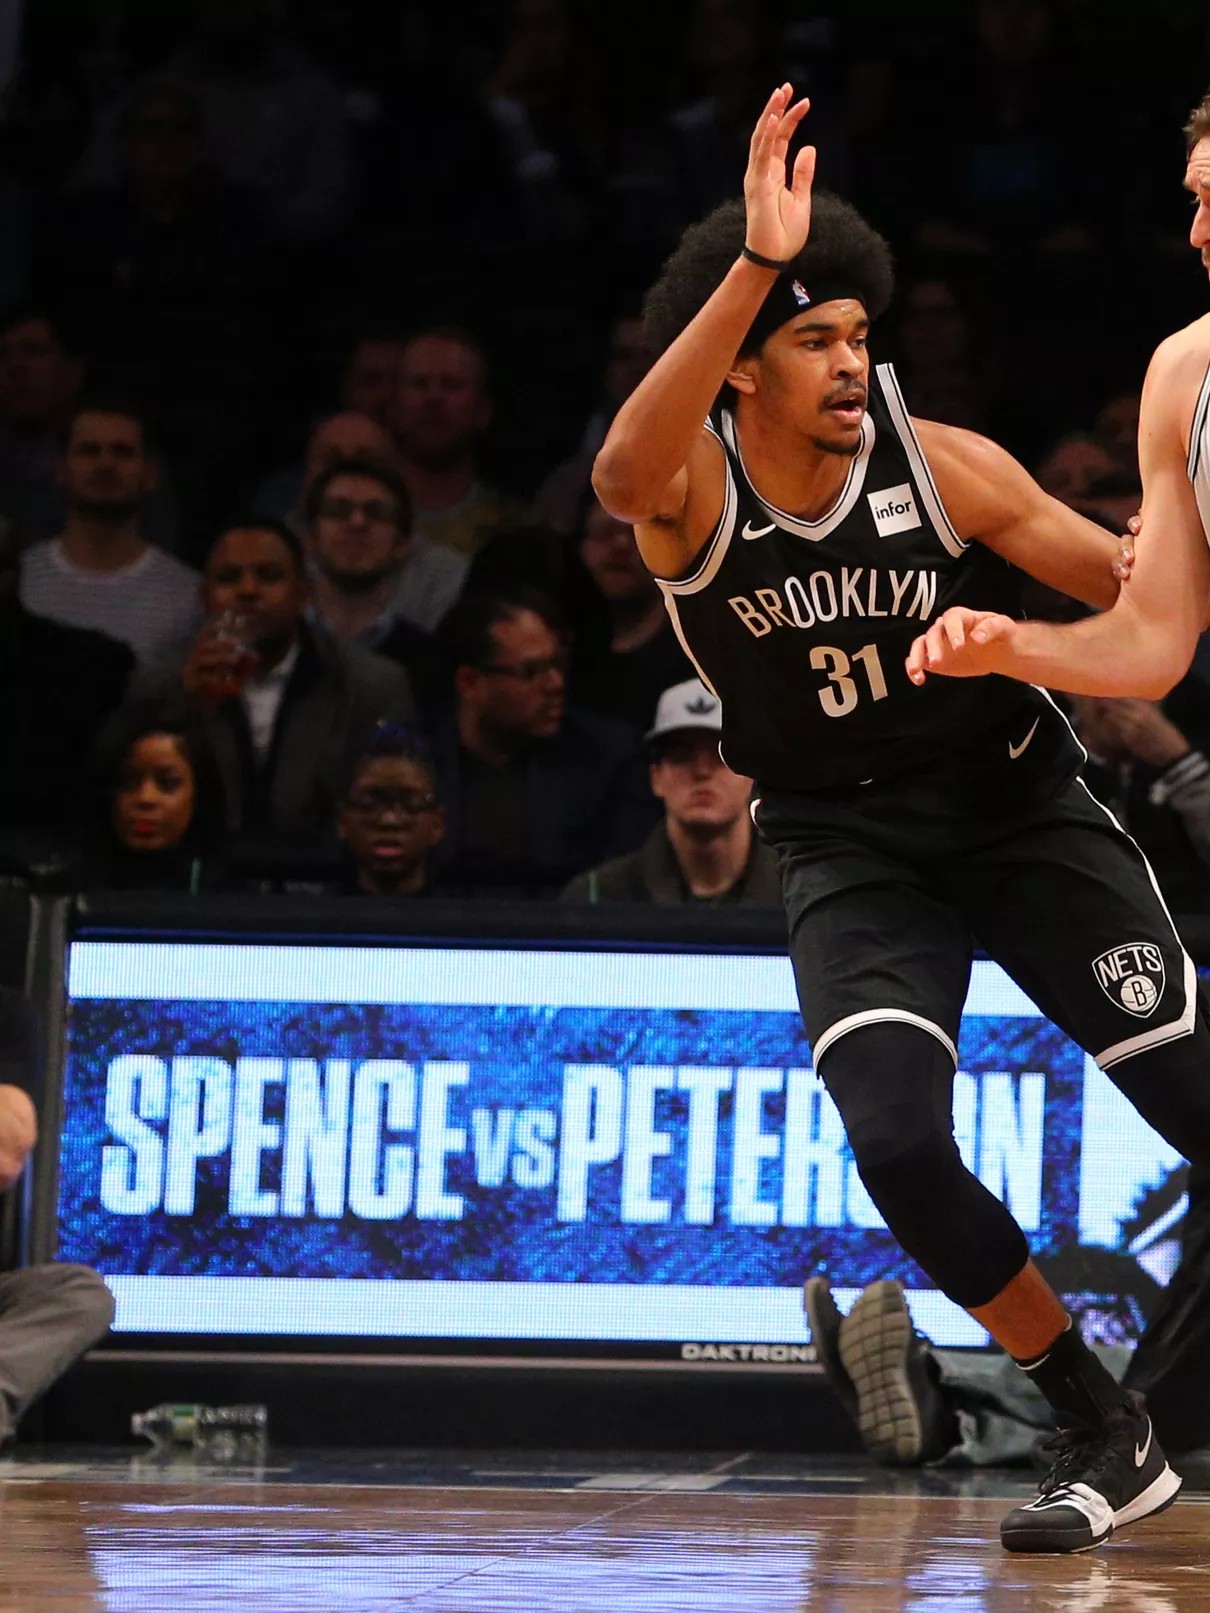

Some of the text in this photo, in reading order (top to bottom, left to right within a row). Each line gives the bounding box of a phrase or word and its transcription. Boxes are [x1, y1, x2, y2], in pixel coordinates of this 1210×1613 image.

[874, 499, 912, 520] infor
[727, 566, 937, 638] BROOKLYN
[809, 643, 888, 718] 31
[1098, 945, 1161, 988] NETS
[1131, 980, 1147, 1007] B
[100, 1053, 470, 1220] SPENCE
[556, 1062, 1047, 1230] PETERN
[681, 1343, 817, 1362] DAKTRONI
